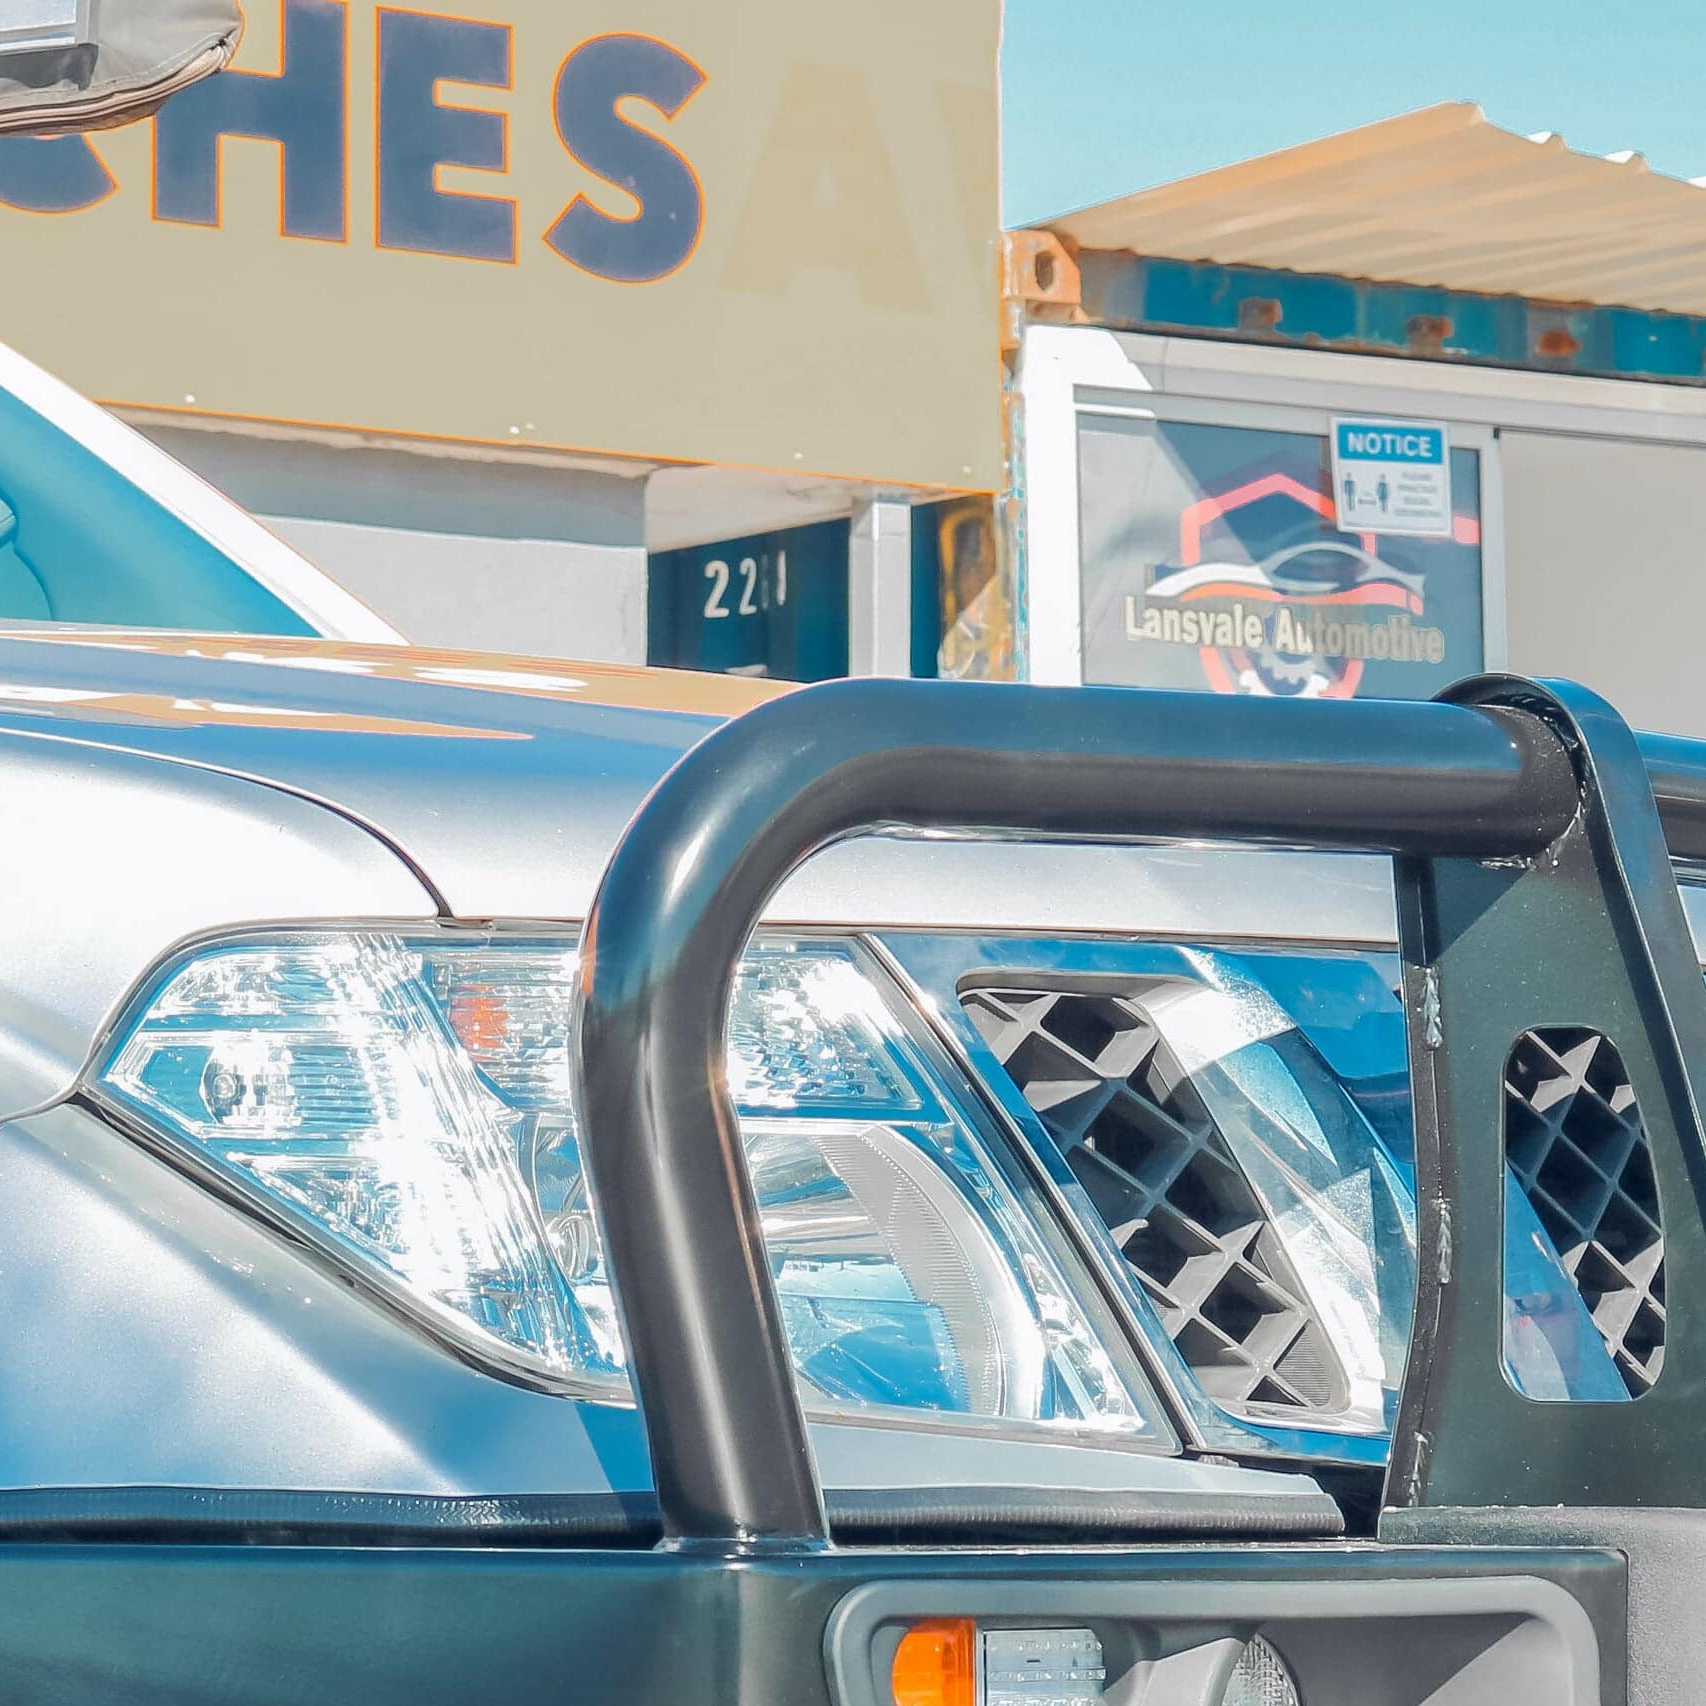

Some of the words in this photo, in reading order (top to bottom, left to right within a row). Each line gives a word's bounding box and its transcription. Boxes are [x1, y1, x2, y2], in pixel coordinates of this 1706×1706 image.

[1347, 431, 1433, 458] NOTICE
[1124, 595, 1265, 649] Lansvale
[1275, 607, 1445, 664] Automotive
